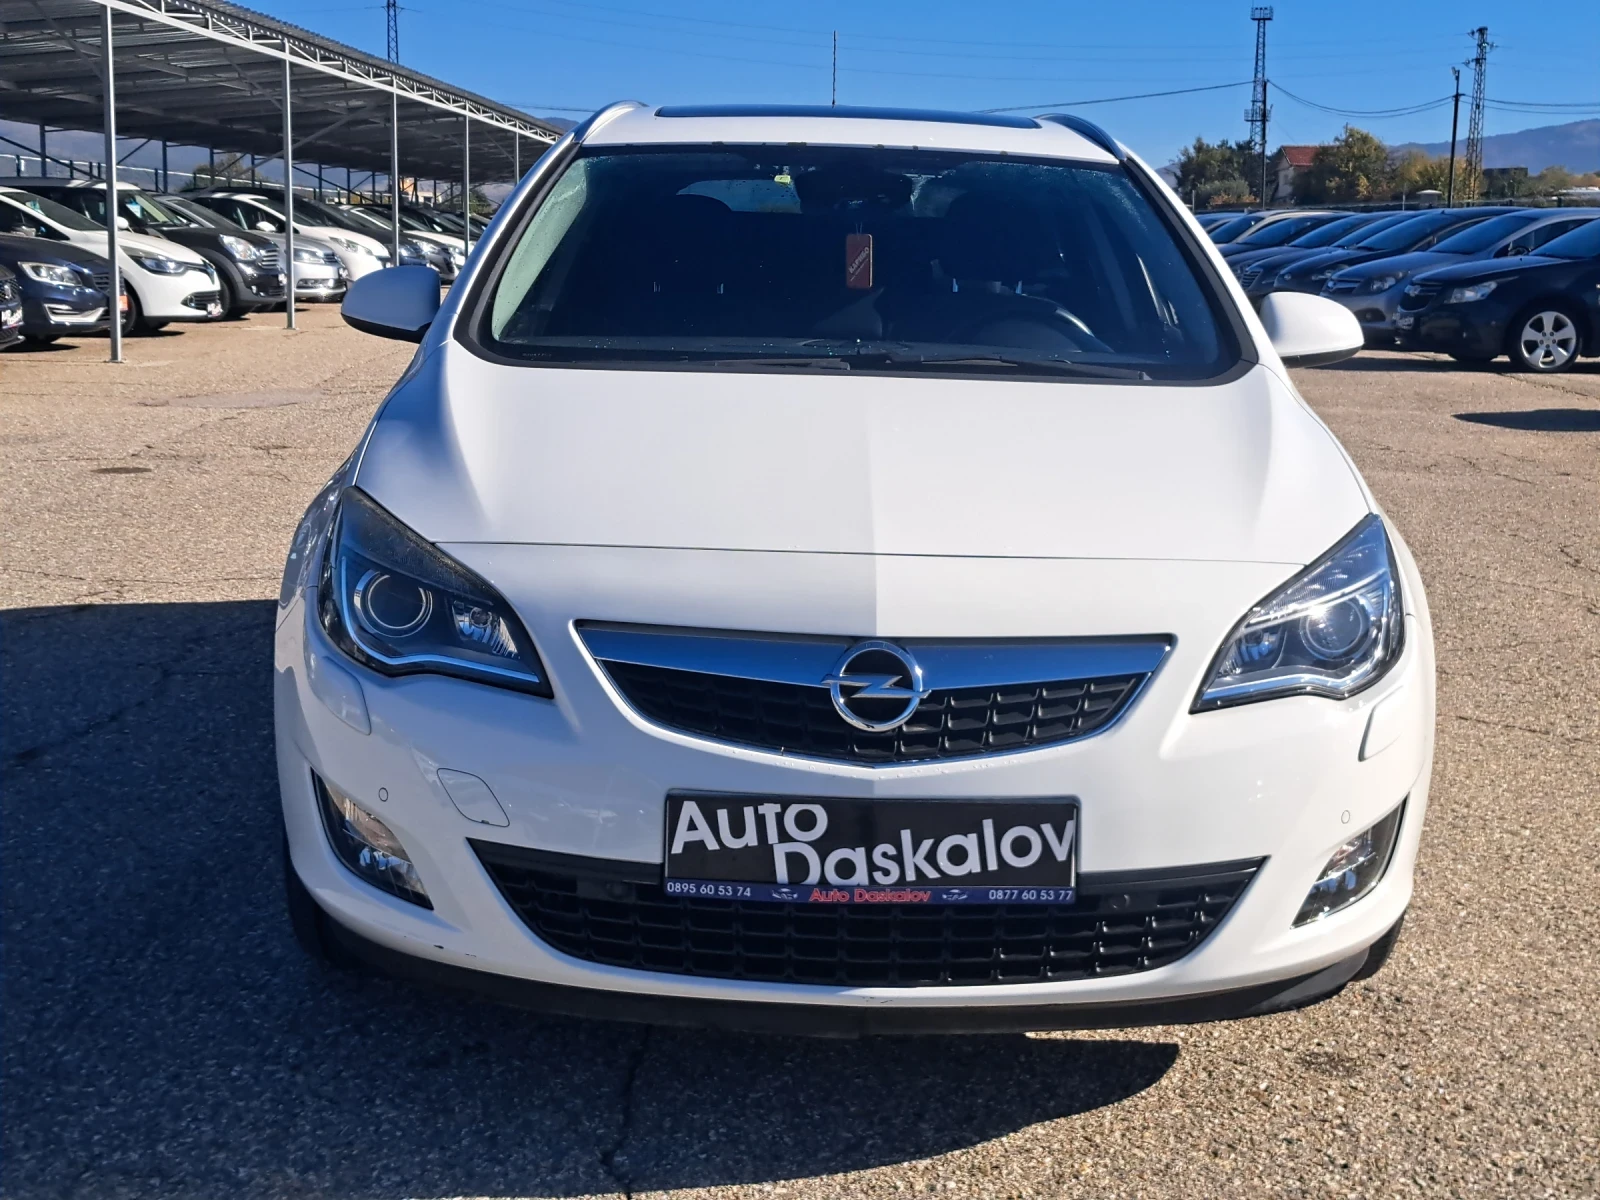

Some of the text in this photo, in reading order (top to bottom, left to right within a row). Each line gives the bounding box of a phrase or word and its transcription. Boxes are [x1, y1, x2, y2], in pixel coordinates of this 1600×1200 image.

[671, 800, 828, 854] Auto
[773, 818, 1075, 886] Daskalov
[667, 882, 751, 897] 0895 60 53 74
[810, 888, 932, 902] Auto Daskalov
[988, 890, 1073, 900] 0877 60 53 77
